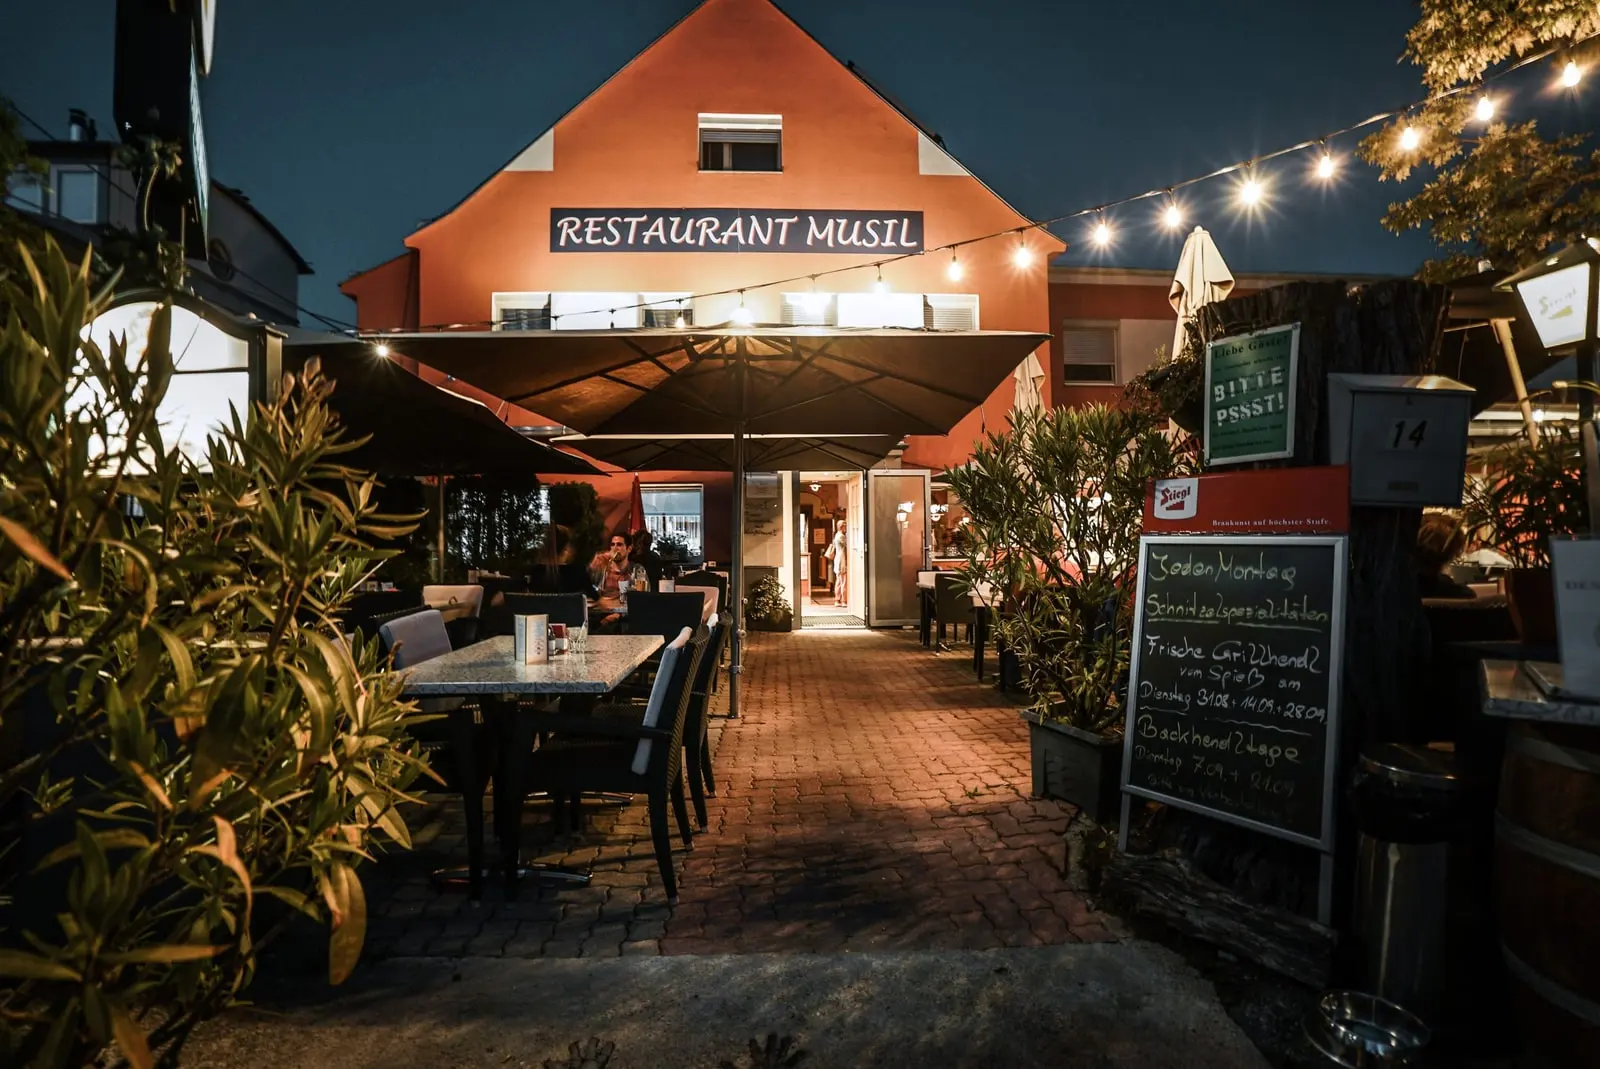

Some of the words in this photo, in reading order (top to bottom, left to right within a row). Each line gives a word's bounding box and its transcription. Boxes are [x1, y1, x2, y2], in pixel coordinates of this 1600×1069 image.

[556, 214, 798, 248] RESTAURANT
[806, 215, 918, 248] MUSIL
[1214, 366, 1284, 403] BITTE
[1216, 391, 1285, 427] PSSST!
[1393, 420, 1427, 450] 14
[1160, 485, 1191, 506] Stiegl
[1212, 519, 1251, 527] Braukunst
[1253, 518, 1266, 526] auf
[1146, 634, 1206, 659] Frische
[1207, 665, 1265, 691] Spieß
[1277, 678, 1301, 692] am
[1139, 680, 1192, 711] Dienstag
